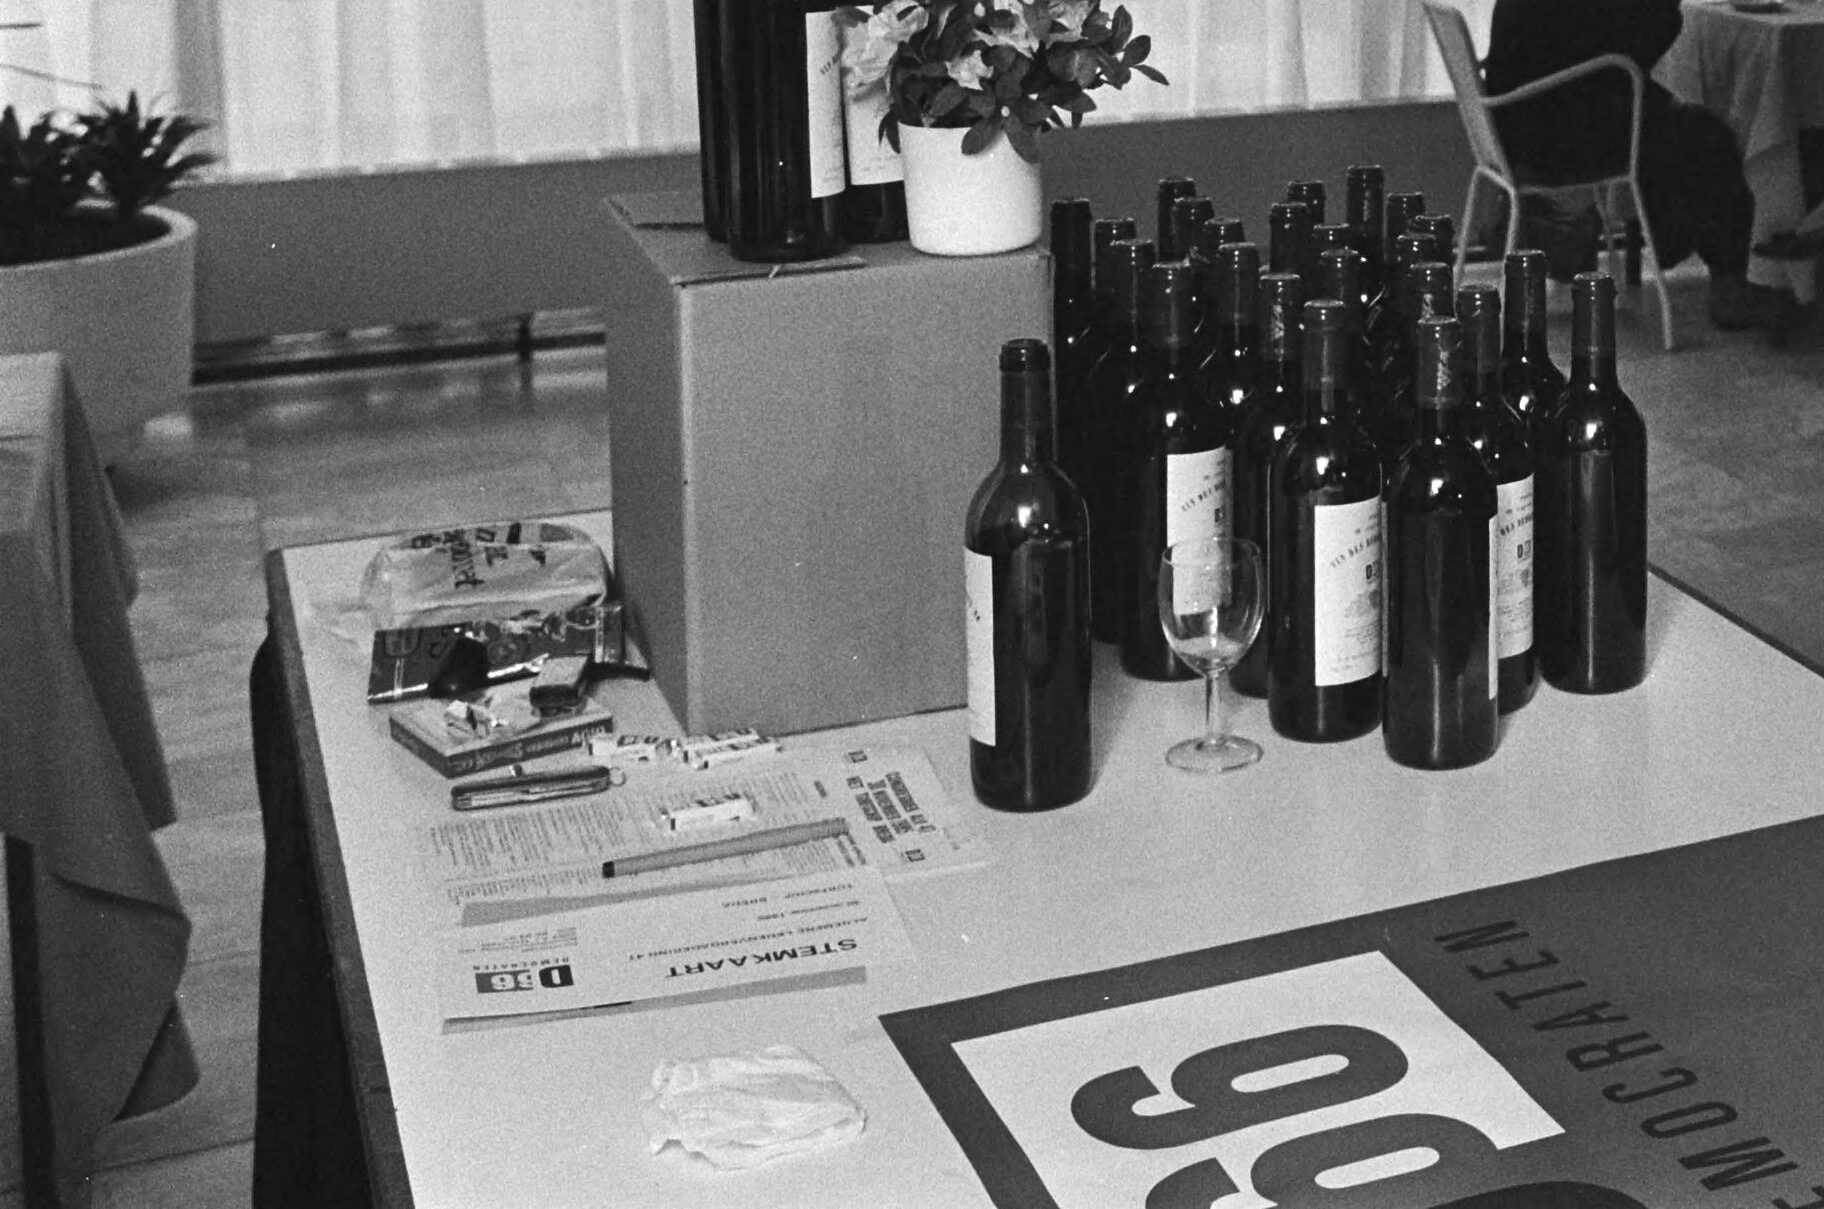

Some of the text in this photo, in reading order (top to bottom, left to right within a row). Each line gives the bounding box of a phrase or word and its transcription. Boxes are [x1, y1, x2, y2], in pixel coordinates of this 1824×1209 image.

[665, 938, 857, 977] STEMKAART
[476, 964, 574, 994] D66
[1070, 1023, 1648, 1209] 66
